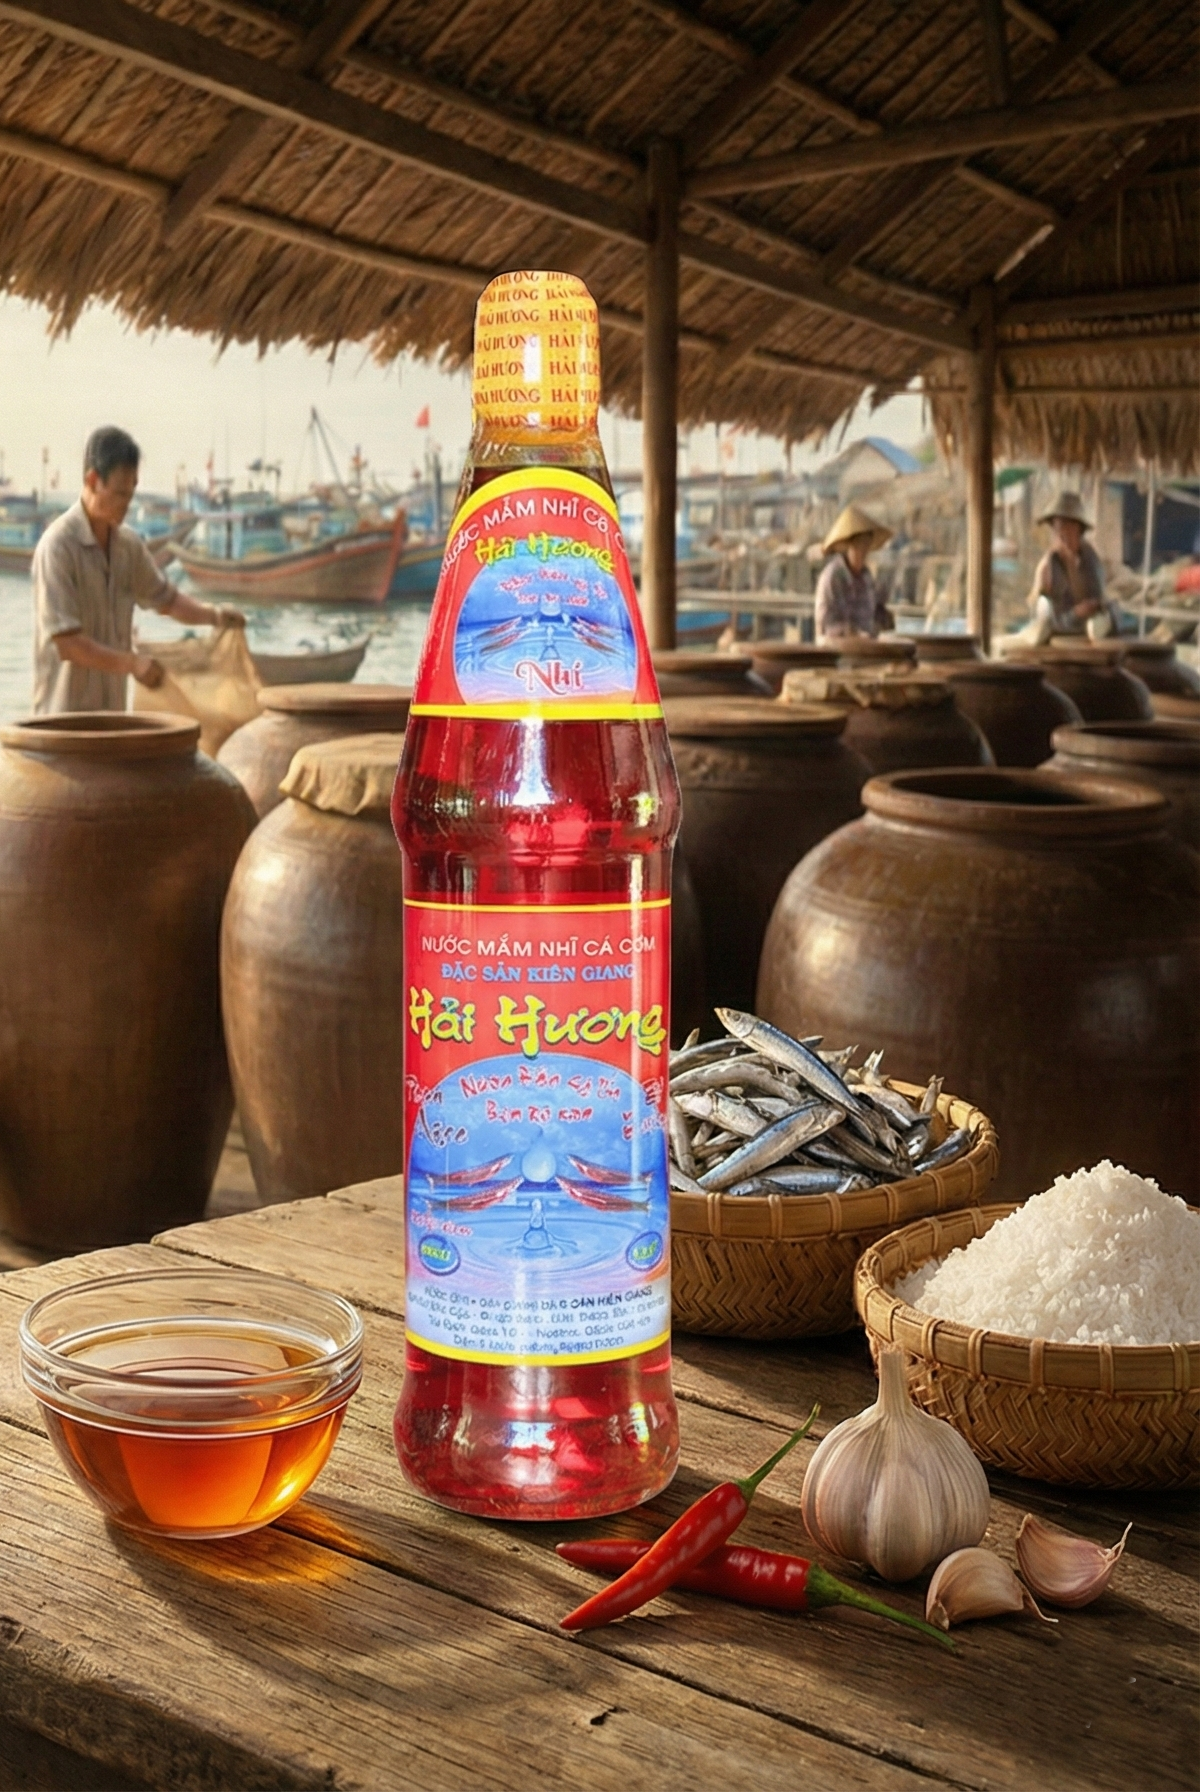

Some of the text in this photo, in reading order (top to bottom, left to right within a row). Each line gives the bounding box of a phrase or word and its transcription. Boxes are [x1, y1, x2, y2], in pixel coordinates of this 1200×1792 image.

[549, 303, 573, 322] HẢI
[549, 328, 576, 348] HẢI
[550, 355, 577, 375] HẢI
[552, 382, 578, 403] HẢI
[421, 934, 472, 955] NƯỚC
[477, 933, 532, 957] MẮM
[540, 936, 579, 957] NHĨ
[583, 935, 614, 956] CÁ
[441, 961, 477, 983] ĐẶC
[527, 963, 576, 983] KIÊN
[581, 963, 636, 982] GIANG
[408, 985, 667, 1059] Hải Hương
